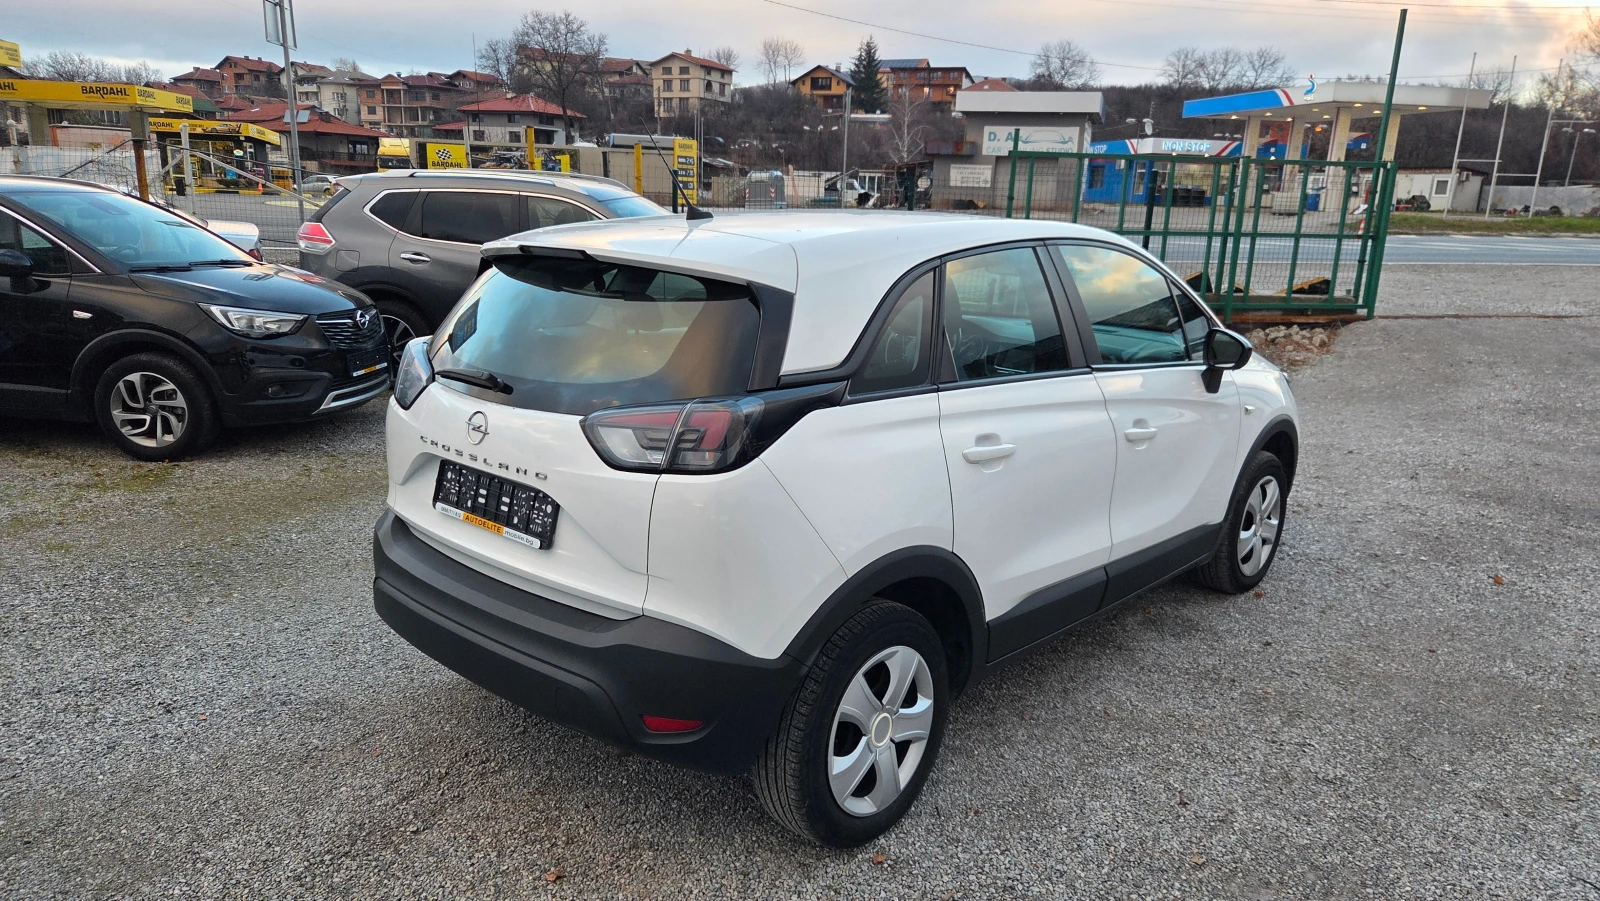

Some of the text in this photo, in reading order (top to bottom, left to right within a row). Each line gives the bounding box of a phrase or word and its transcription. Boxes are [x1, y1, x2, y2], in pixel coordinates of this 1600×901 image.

[81, 85, 129, 99] BARDAHL
[137, 88, 156, 101] BARDAHL
[175, 96, 192, 108] BARDAHL
[988, 131, 1000, 142] D.
[1094, 144, 1107, 154] STOP
[1162, 141, 1211, 152] NON STOP
[431, 160, 463, 169] BARDAHL
[420, 435, 548, 481] CROSSLAND
[465, 514, 534, 545] AUTOELITE mobile.bg
